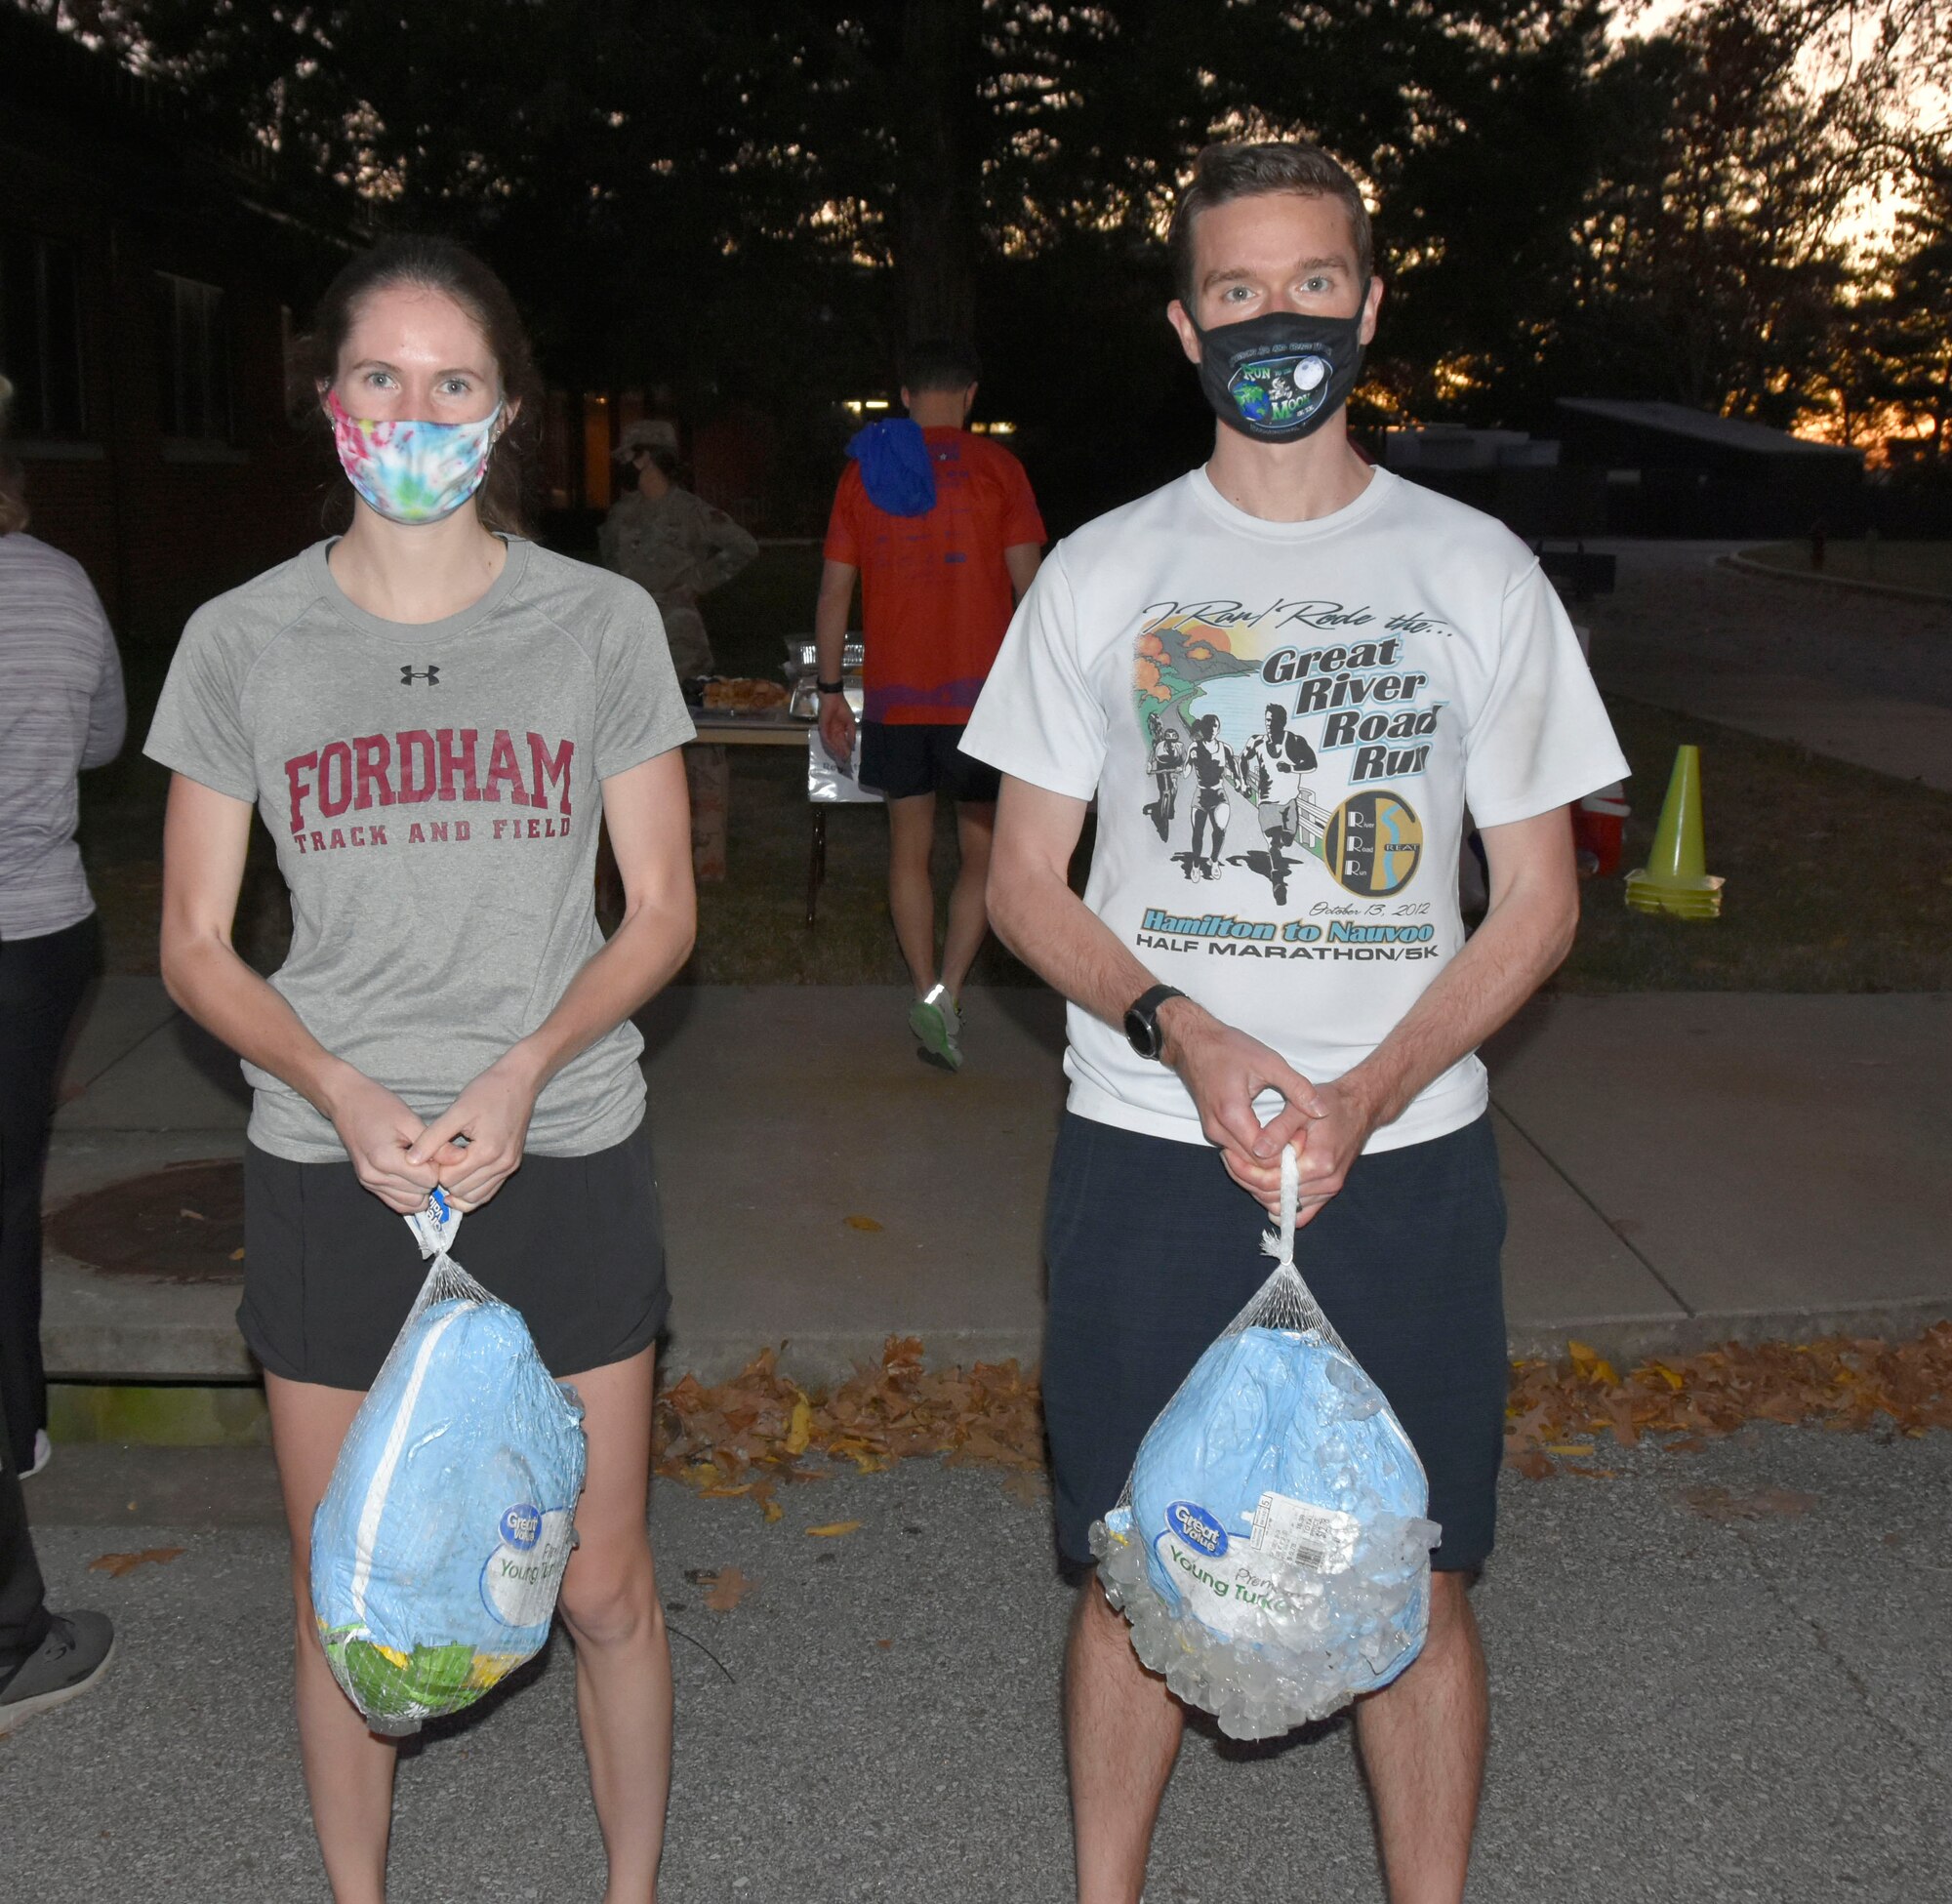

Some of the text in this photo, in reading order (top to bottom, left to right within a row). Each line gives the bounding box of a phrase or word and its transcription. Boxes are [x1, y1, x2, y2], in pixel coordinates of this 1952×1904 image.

[1262, 635, 1402, 684] Great
[1295, 671, 1428, 715] River
[1321, 704, 1444, 749] Road
[1350, 743, 1432, 782] Run
[285, 728, 574, 835] FORDHAM
[294, 817, 571, 854] TRACK AND FIELD
[1345, 860, 1366, 875] Run
[1142, 909, 1434, 944] Hamilton to Nauvoo
[1309, 902, 1431, 916] October 13, 2012
[1135, 934, 1440, 961] HALF MARATHON/5K
[507, 1512, 538, 1530] Great
[1175, 1505, 1220, 1543] Great
[1183, 1524, 1216, 1553] Value
[501, 1559, 538, 1586] Young
[1170, 1544, 1229, 1598] Young
